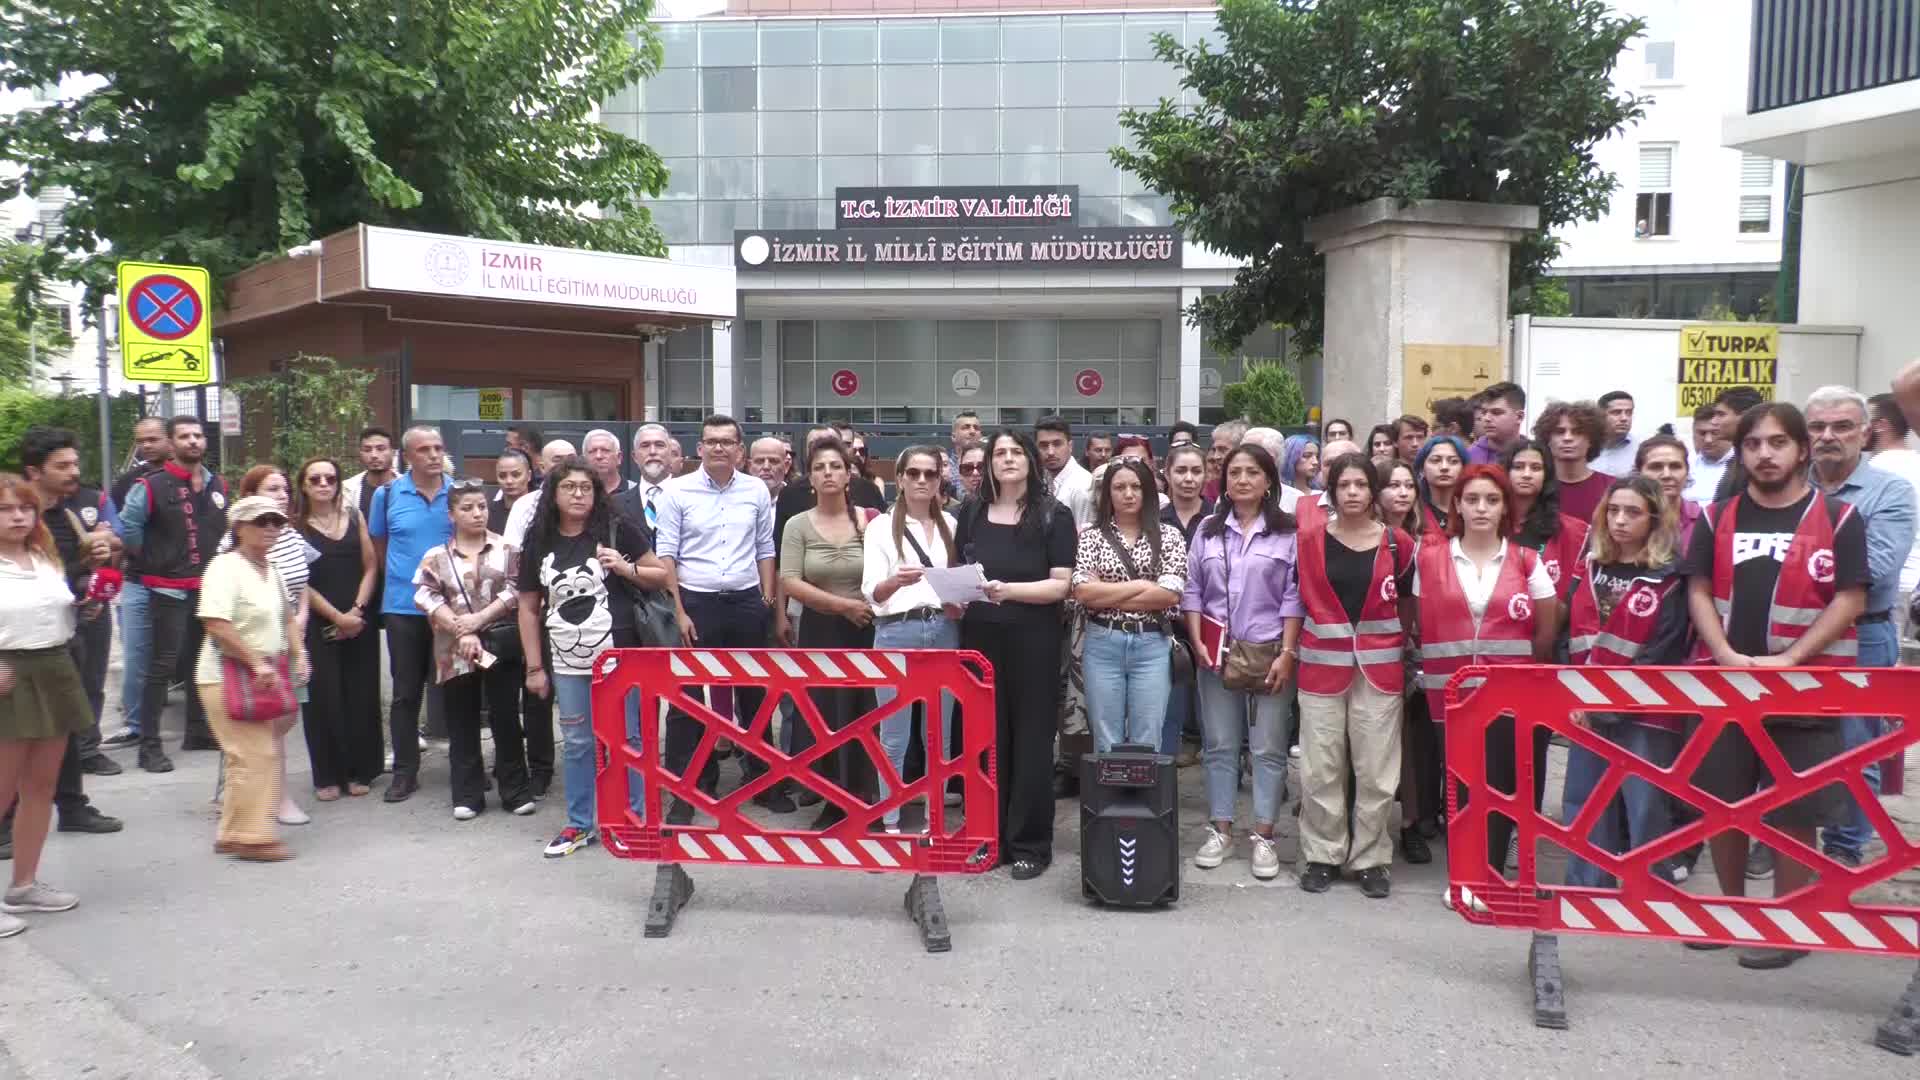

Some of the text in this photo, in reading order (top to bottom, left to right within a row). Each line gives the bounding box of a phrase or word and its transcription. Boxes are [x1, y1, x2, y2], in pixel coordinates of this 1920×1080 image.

[841, 194, 1072, 218] T.C. İZMİR VALİLİĞİ
[482, 248, 542, 272] İZMİR
[773, 234, 1173, 262] İZMİR İL MİLLÎ EĞİTİM MÜDÜRLÜĞÜ
[482, 269, 496, 288] İL
[547, 277, 600, 297] EĞİTİM
[603, 282, 697, 305] MÜDÜRLÜĞÜ
[1706, 335, 1768, 353] TURPA
